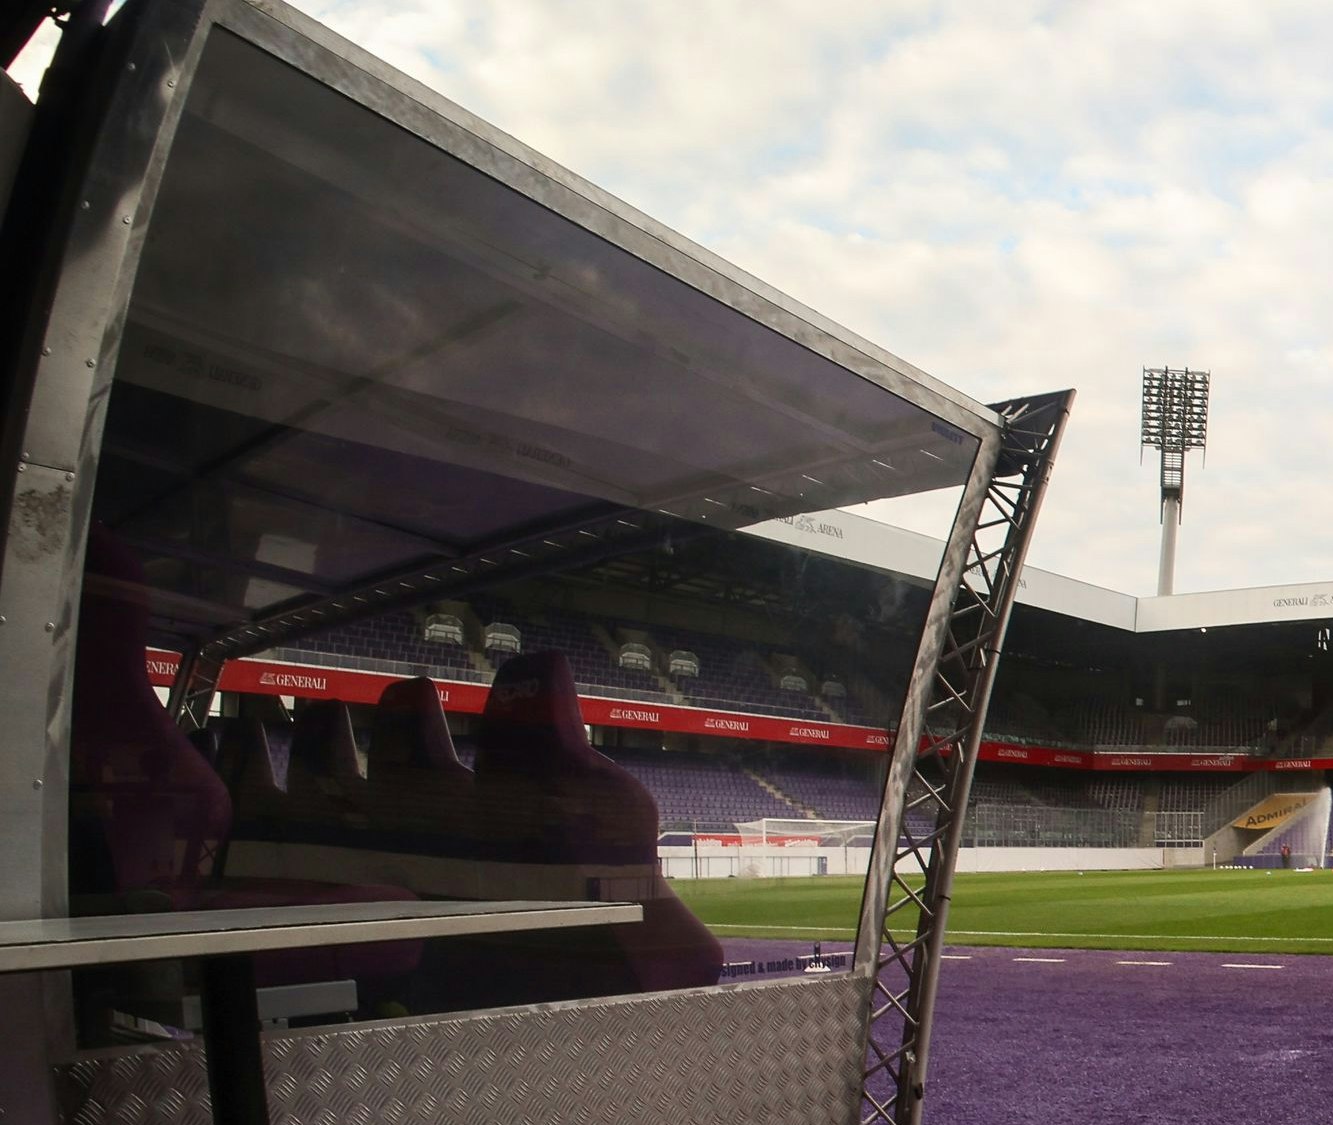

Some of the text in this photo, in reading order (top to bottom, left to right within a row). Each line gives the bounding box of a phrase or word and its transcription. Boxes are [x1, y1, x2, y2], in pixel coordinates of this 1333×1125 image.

[817, 523, 843, 539] ARENA
[1273, 596, 1308, 608] GENERALI
[276, 673, 327, 690] GENERALI
[621, 710, 660, 723] GENERALI
[714, 719, 749, 731] GENERALI
[798, 728, 830, 740] GENERALI
[1121, 757, 1152, 766] GENERALI
[1201, 758, 1231, 767] GENERALI
[1284, 760, 1311, 768] GENERALI
[757, 963, 765, 974] &
[767, 960, 794, 973] made
[796, 956, 806, 971] by
